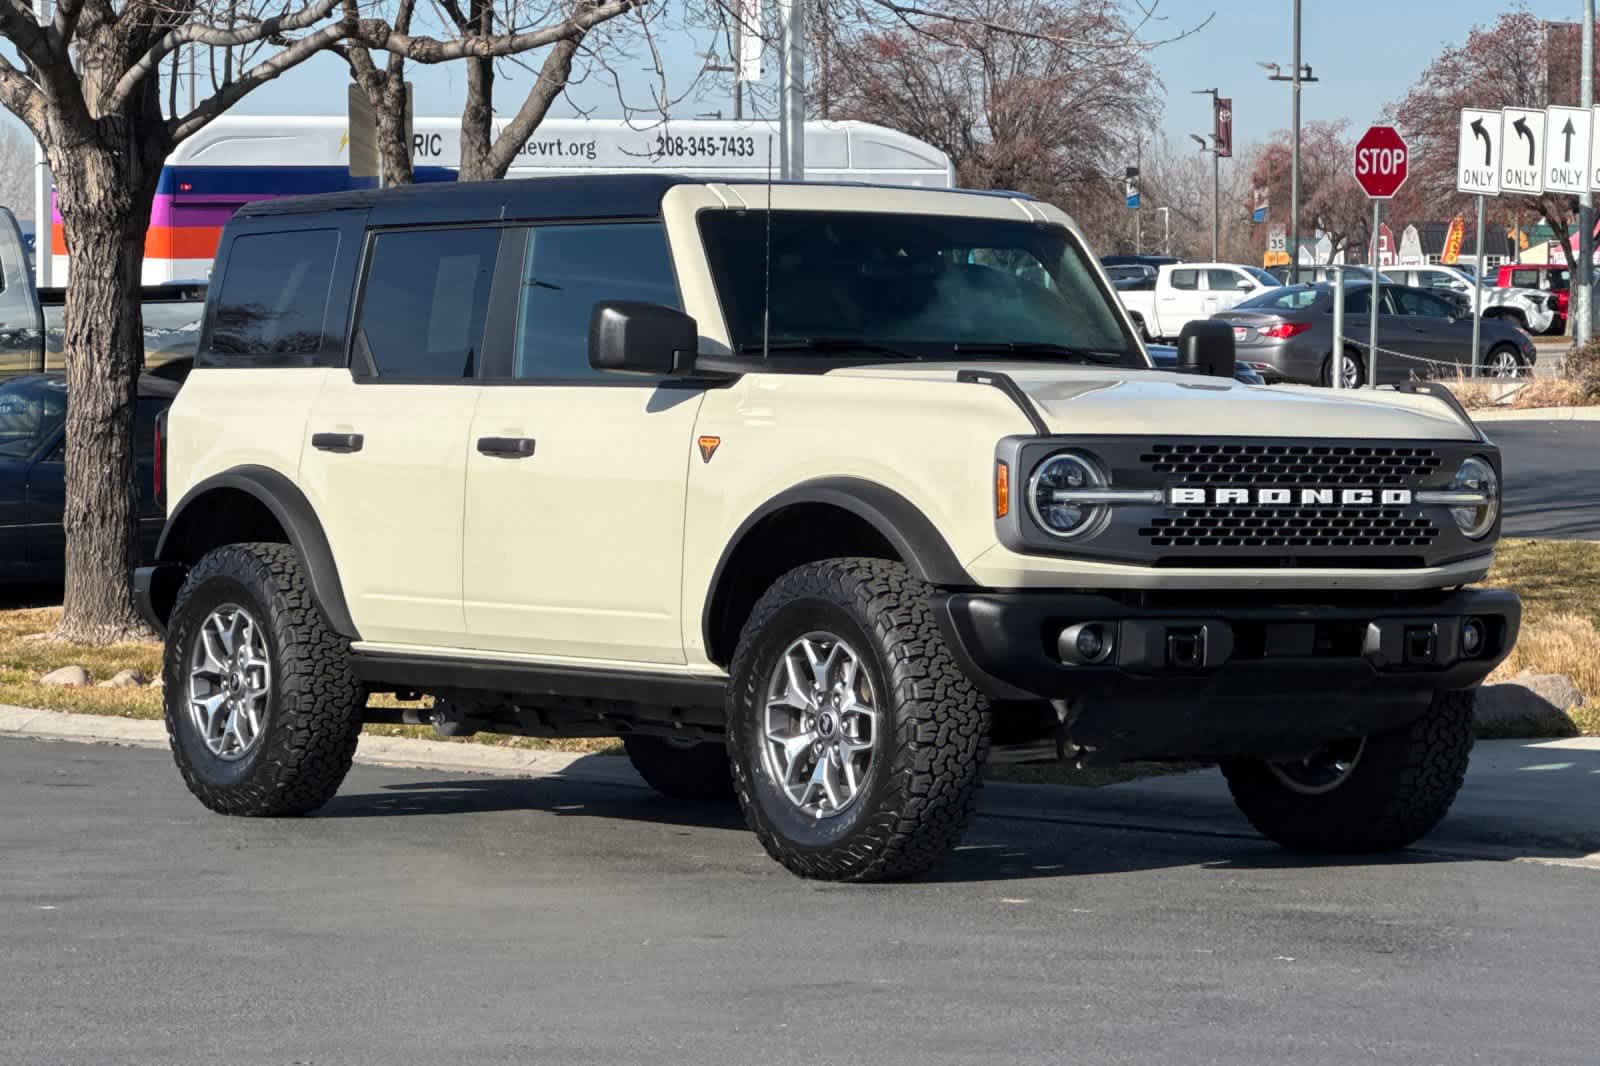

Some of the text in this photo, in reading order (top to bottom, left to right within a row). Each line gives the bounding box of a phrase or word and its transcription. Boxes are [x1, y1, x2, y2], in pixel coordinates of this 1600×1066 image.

[657, 136, 754, 156] 208-345-7433
[1358, 148, 1405, 175] STOP
[1464, 168, 1494, 187] ONLY
[1506, 168, 1537, 187] ONLY
[1551, 167, 1582, 186] ONLY
[1271, 238, 1285, 249] 35
[1171, 488, 1412, 504] BRONCO
